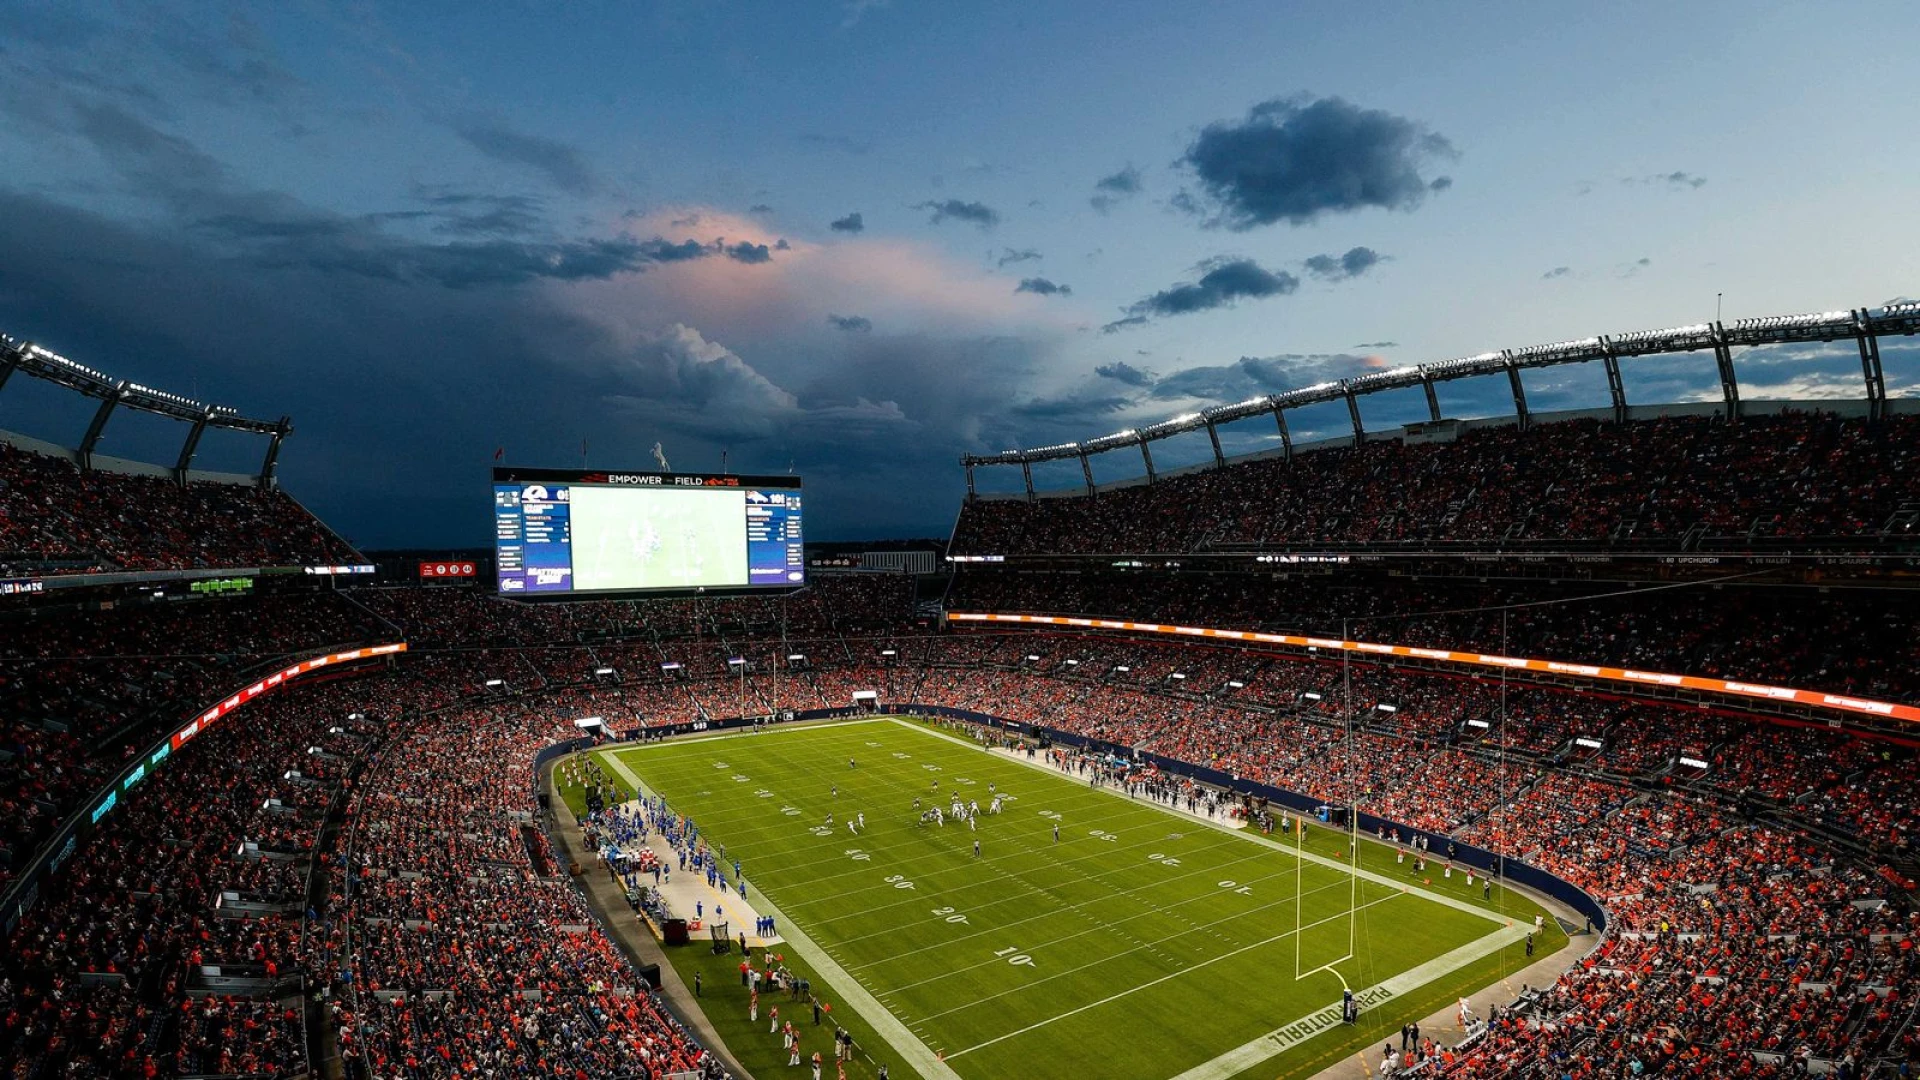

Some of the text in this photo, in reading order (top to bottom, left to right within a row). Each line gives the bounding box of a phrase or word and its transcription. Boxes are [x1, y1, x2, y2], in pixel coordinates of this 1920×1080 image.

[608, 474, 662, 485] EMPOWER
[675, 477, 703, 486] FIELD
[884, 874, 914, 889] 30
[931, 906, 967, 923] 20
[993, 946, 1032, 966] 10
[1268, 1003, 1344, 1047] OOTBALL
